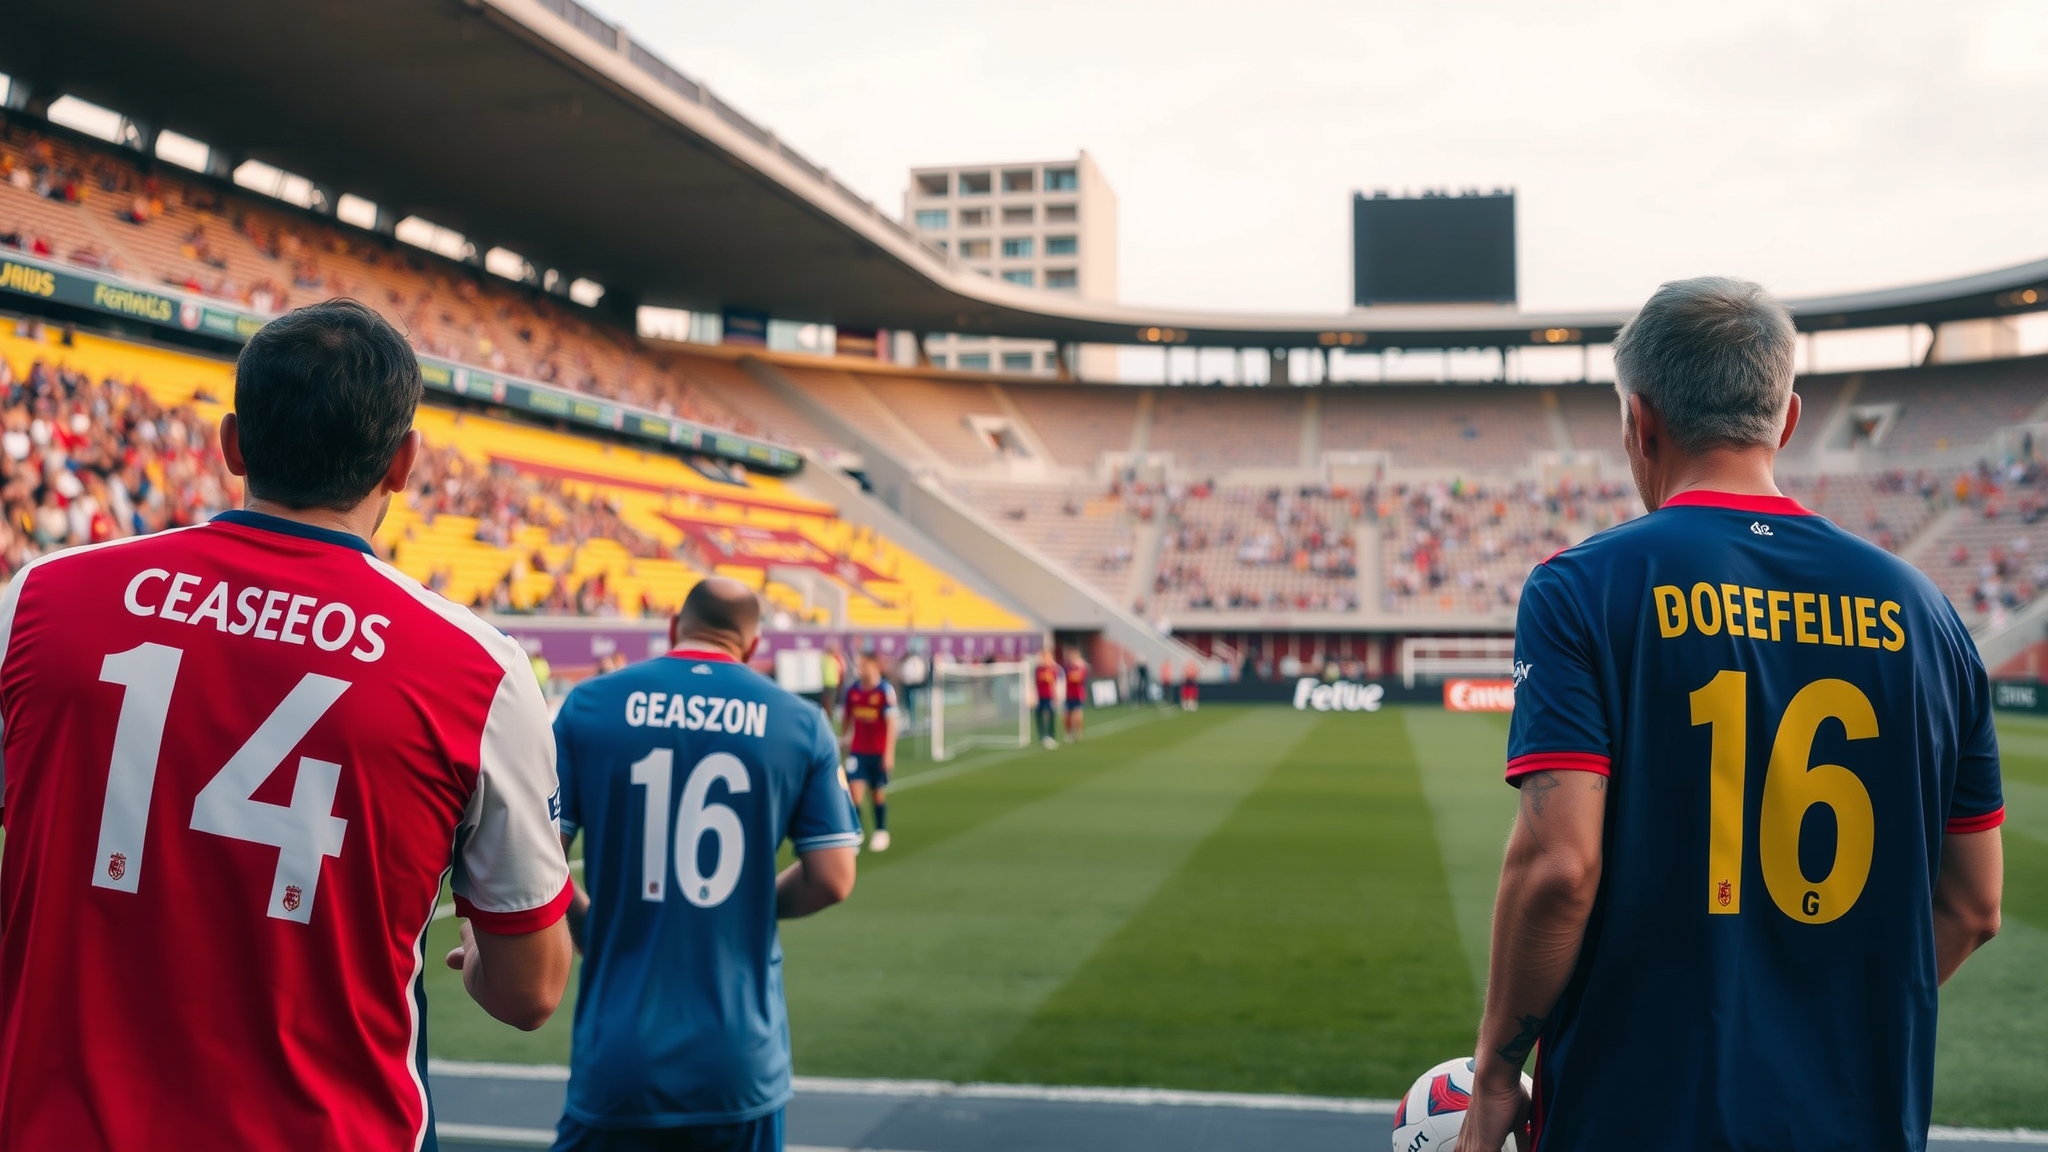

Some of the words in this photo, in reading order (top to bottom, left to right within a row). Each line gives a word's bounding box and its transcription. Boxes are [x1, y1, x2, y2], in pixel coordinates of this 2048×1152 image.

[124, 568, 391, 662] CEASEEOS
[625, 691, 768, 737] GEASZON
[92, 641, 352, 924] 14
[631, 747, 751, 908] 16
[1690, 670, 1879, 924] 16
[1802, 890, 1820, 916] G
